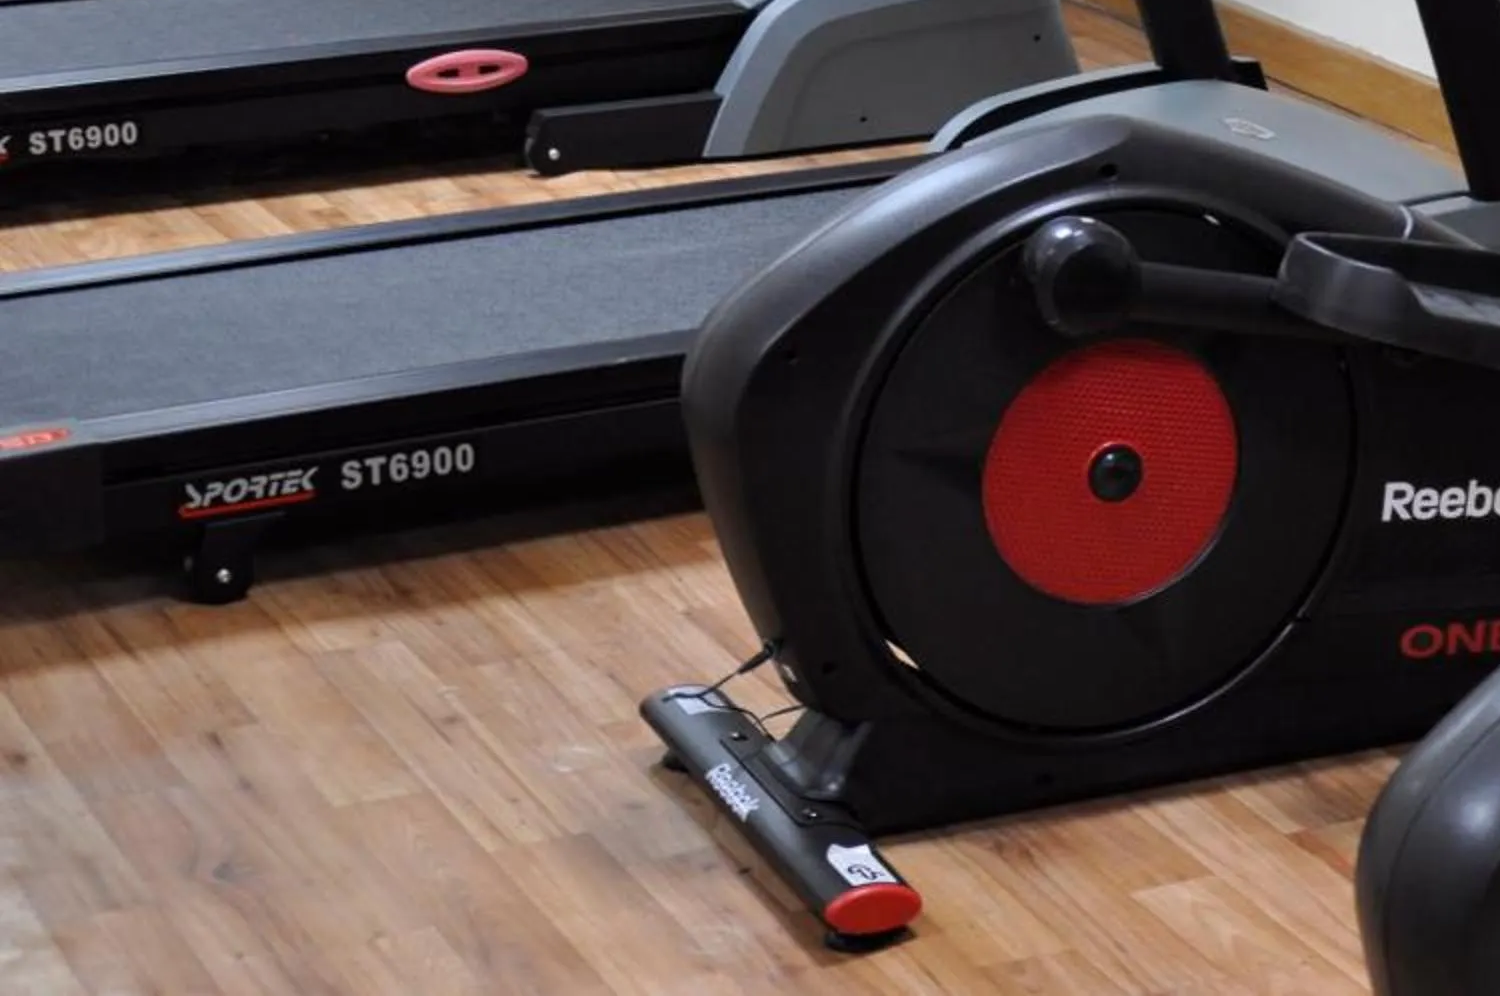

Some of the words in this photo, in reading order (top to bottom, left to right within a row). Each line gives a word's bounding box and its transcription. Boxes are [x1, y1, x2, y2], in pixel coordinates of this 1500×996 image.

[28, 120, 138, 155] ST6900
[184, 465, 320, 509] SPORTEK
[340, 443, 475, 490] ST6900
